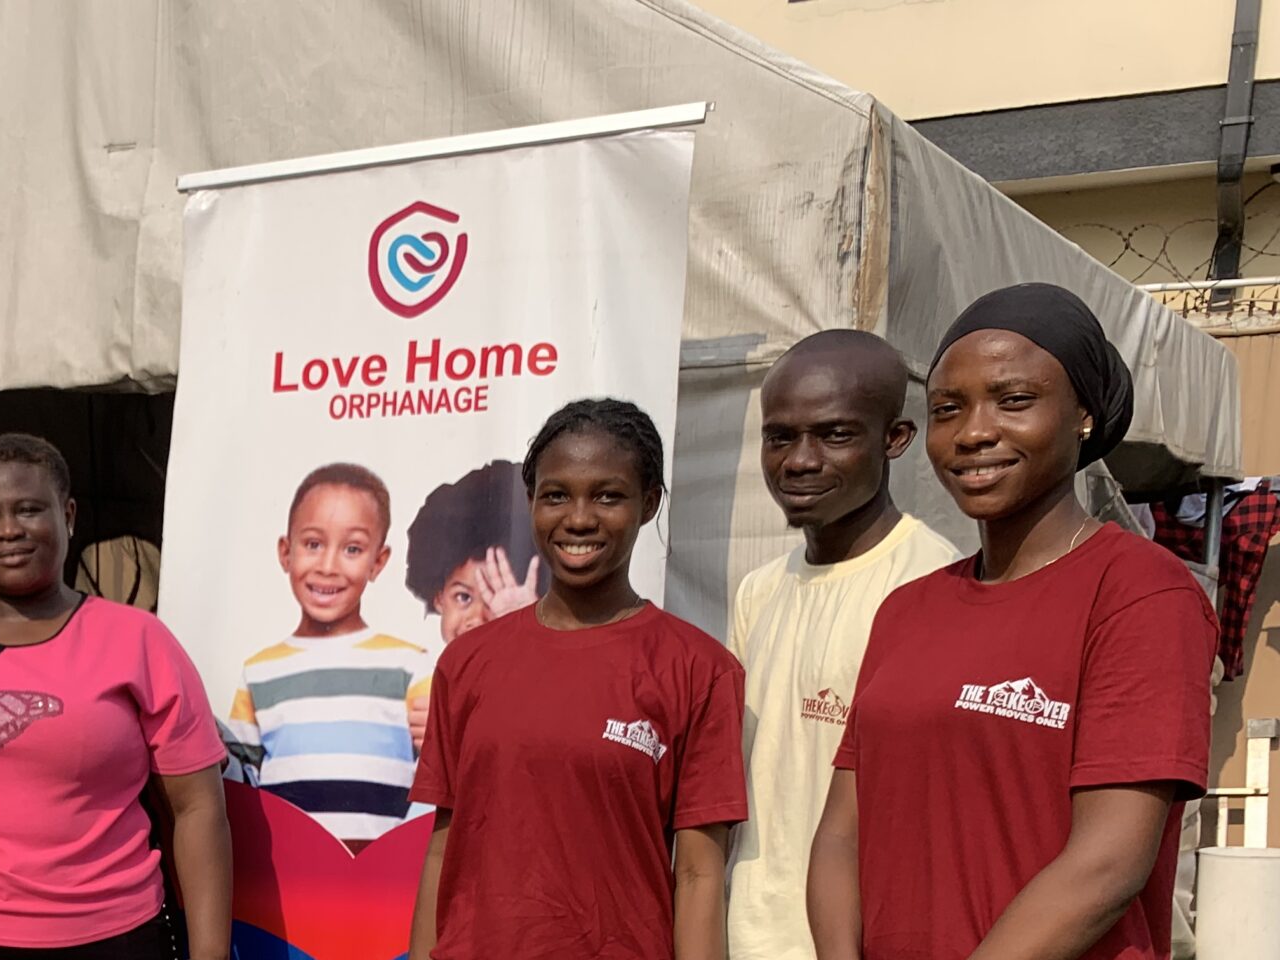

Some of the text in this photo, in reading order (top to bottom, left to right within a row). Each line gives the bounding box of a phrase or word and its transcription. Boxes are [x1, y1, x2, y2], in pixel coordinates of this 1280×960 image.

[273, 338, 558, 393] Love Home
[329, 385, 489, 420] ORPHANAGE
[954, 700, 1065, 729] POWER MOVES ONLY
[959, 680, 1070, 720] THE TAKEOVER
[602, 732, 632, 746] POWER
[606, 719, 626, 737] THE
